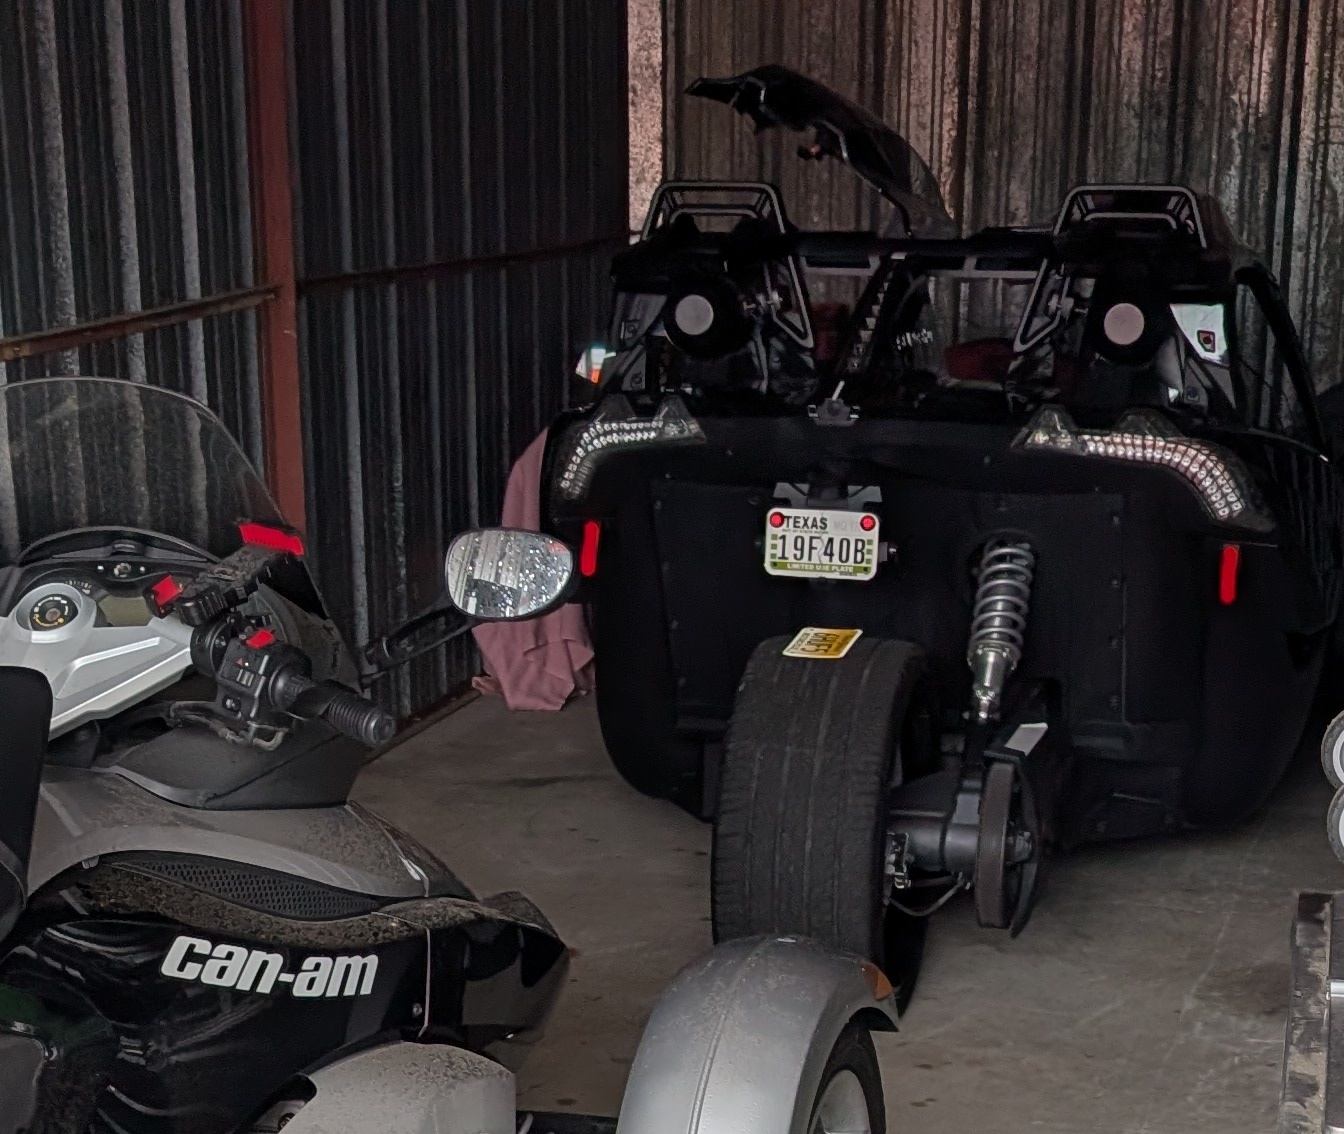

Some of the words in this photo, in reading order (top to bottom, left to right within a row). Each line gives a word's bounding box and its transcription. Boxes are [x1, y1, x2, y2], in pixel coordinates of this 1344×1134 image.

[784, 516, 828, 530] TEXAS
[778, 534, 866, 564] 19F40B
[160, 935, 379, 998] can-am
